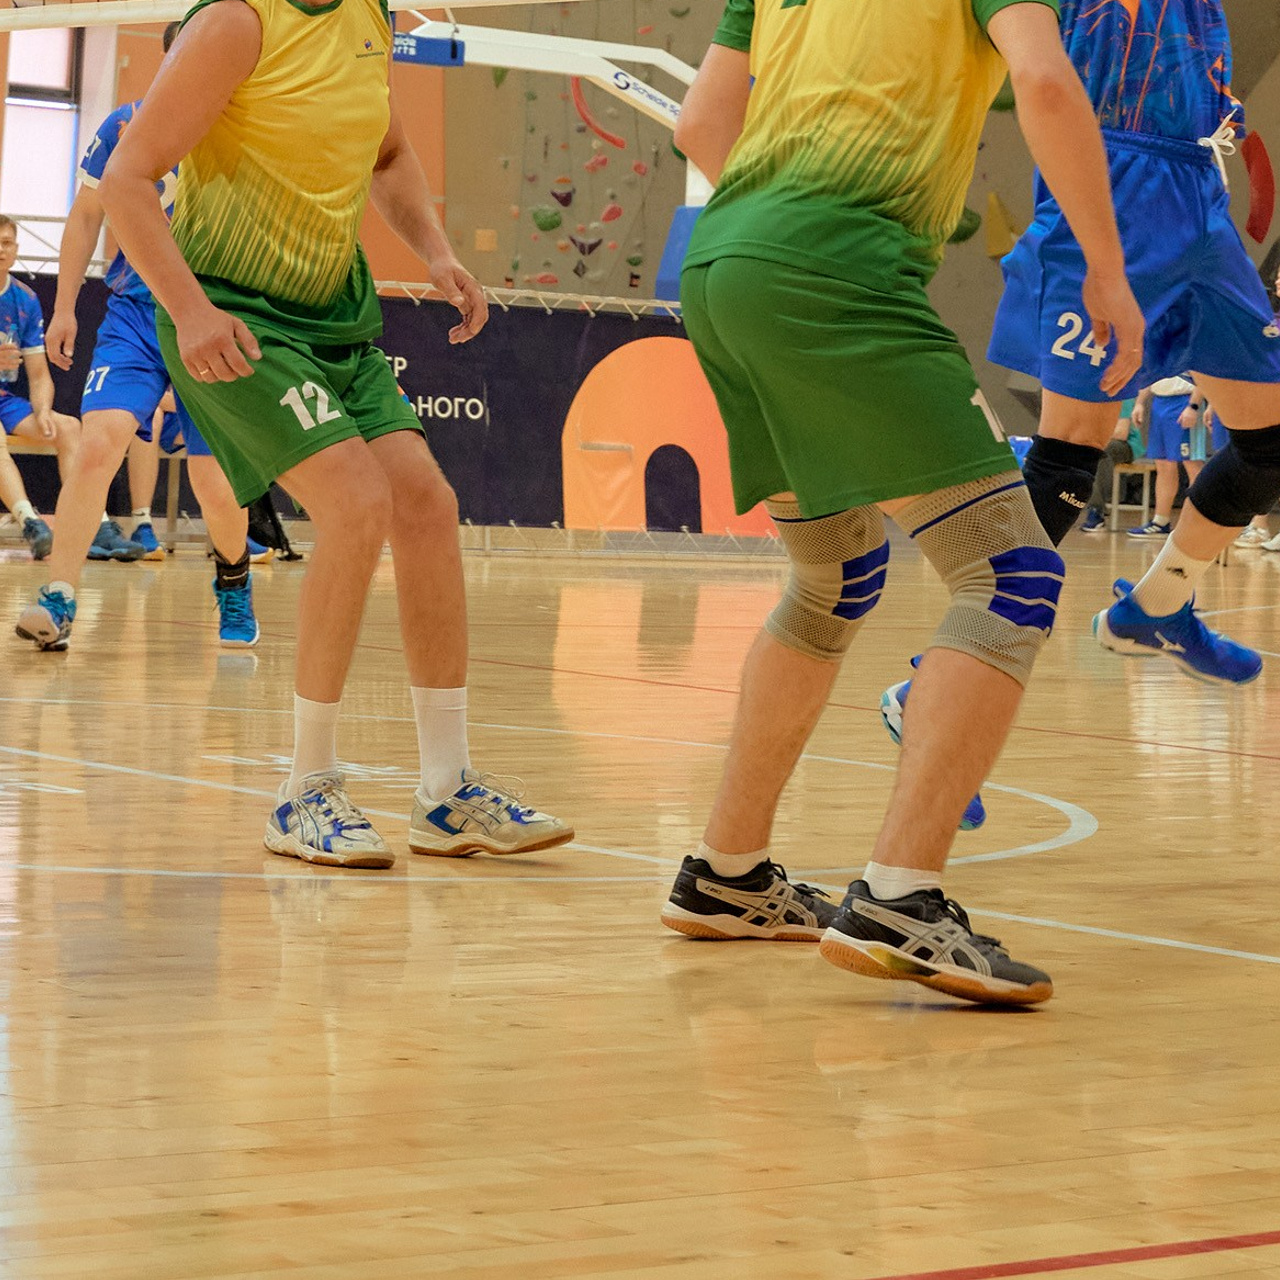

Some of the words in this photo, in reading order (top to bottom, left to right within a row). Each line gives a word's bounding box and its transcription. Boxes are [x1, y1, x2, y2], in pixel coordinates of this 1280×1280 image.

[1051, 312, 1107, 367] 24
[83, 366, 110, 397] 27
[279, 381, 342, 431] 12
